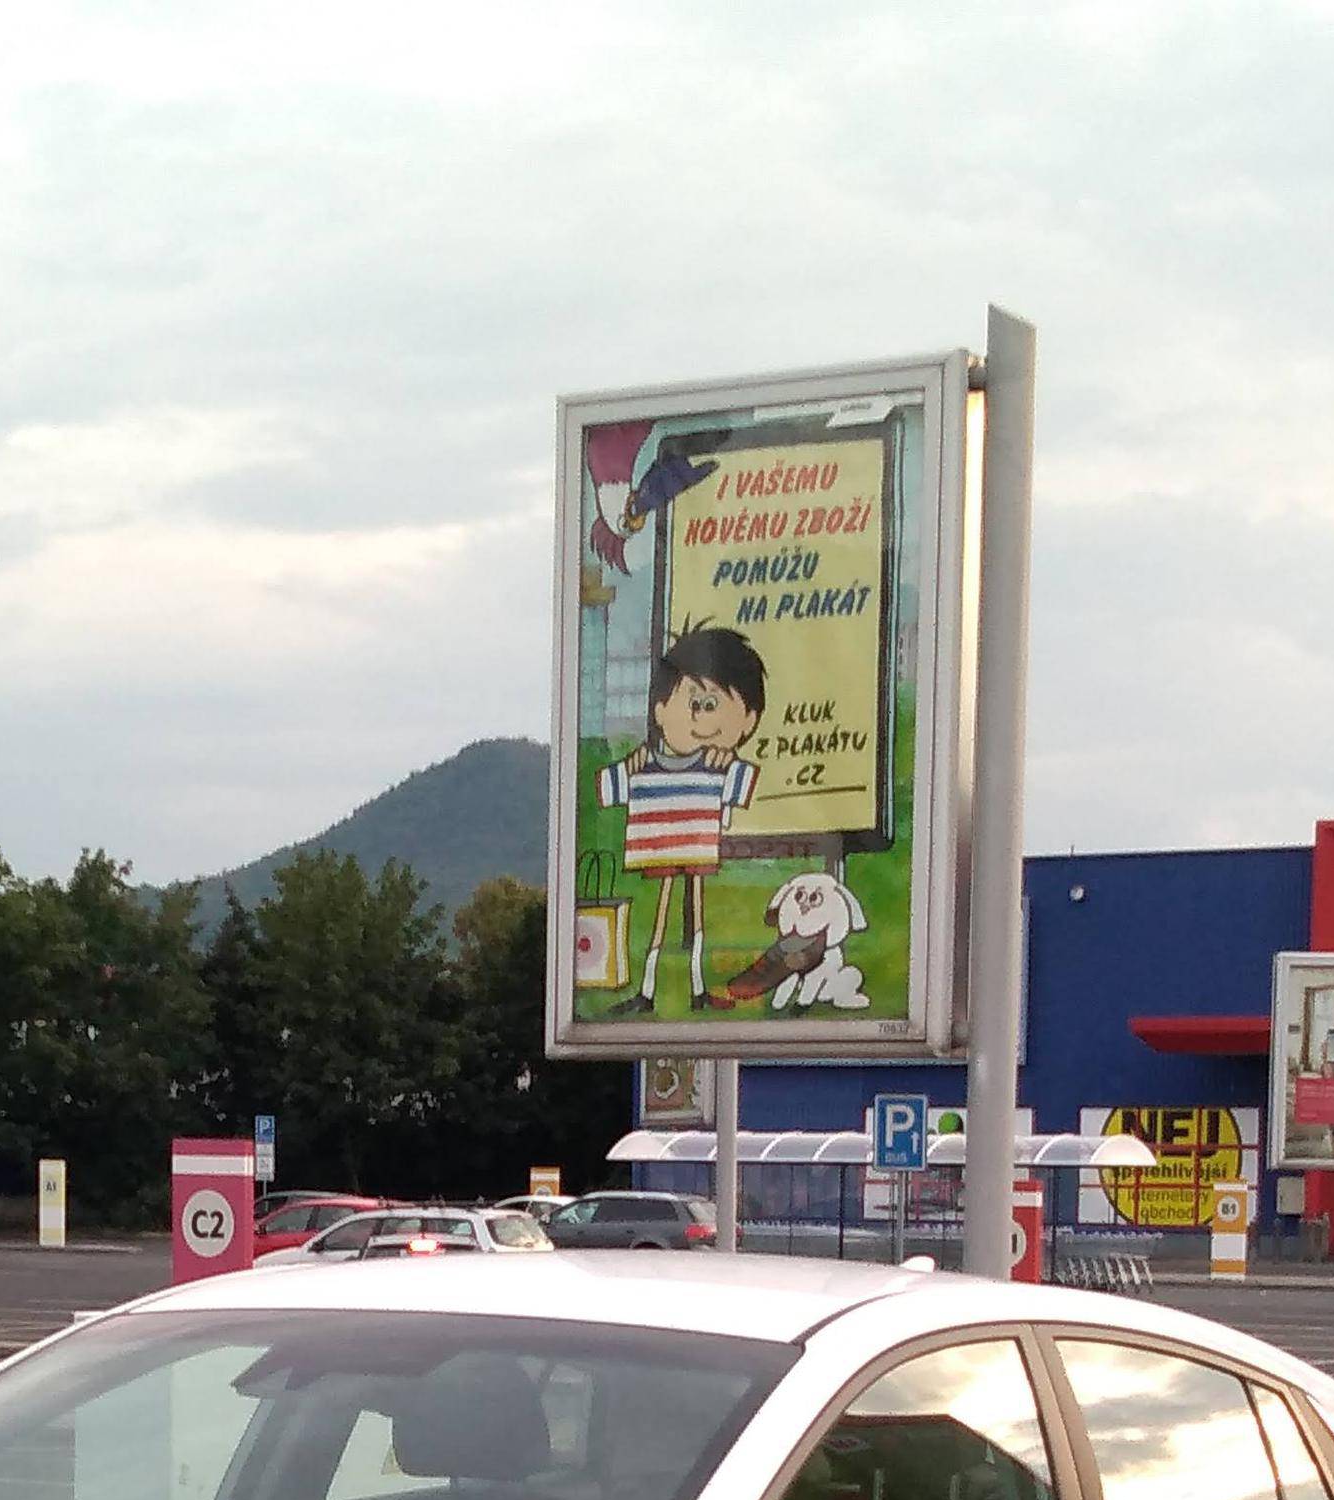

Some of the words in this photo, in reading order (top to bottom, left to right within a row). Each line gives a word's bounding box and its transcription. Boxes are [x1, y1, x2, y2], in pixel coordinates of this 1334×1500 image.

[717, 473, 729, 501] I
[735, 459, 838, 498] VAŠEMU
[684, 506, 788, 547] NOVÉMU
[794, 496, 875, 539] ZBOŽÍ
[712, 546, 820, 588] POMŮŽU
[737, 594, 768, 624] NA
[775, 579, 872, 621] PLAKÁT
[783, 701, 836, 726] KLUK
[755, 737, 770, 760] Z
[776, 725, 867, 760] PLAKÁTU
[785, 763, 826, 786] .CZ
[885, 1104, 915, 1148] P
[190, 1208, 225, 1240] C2
